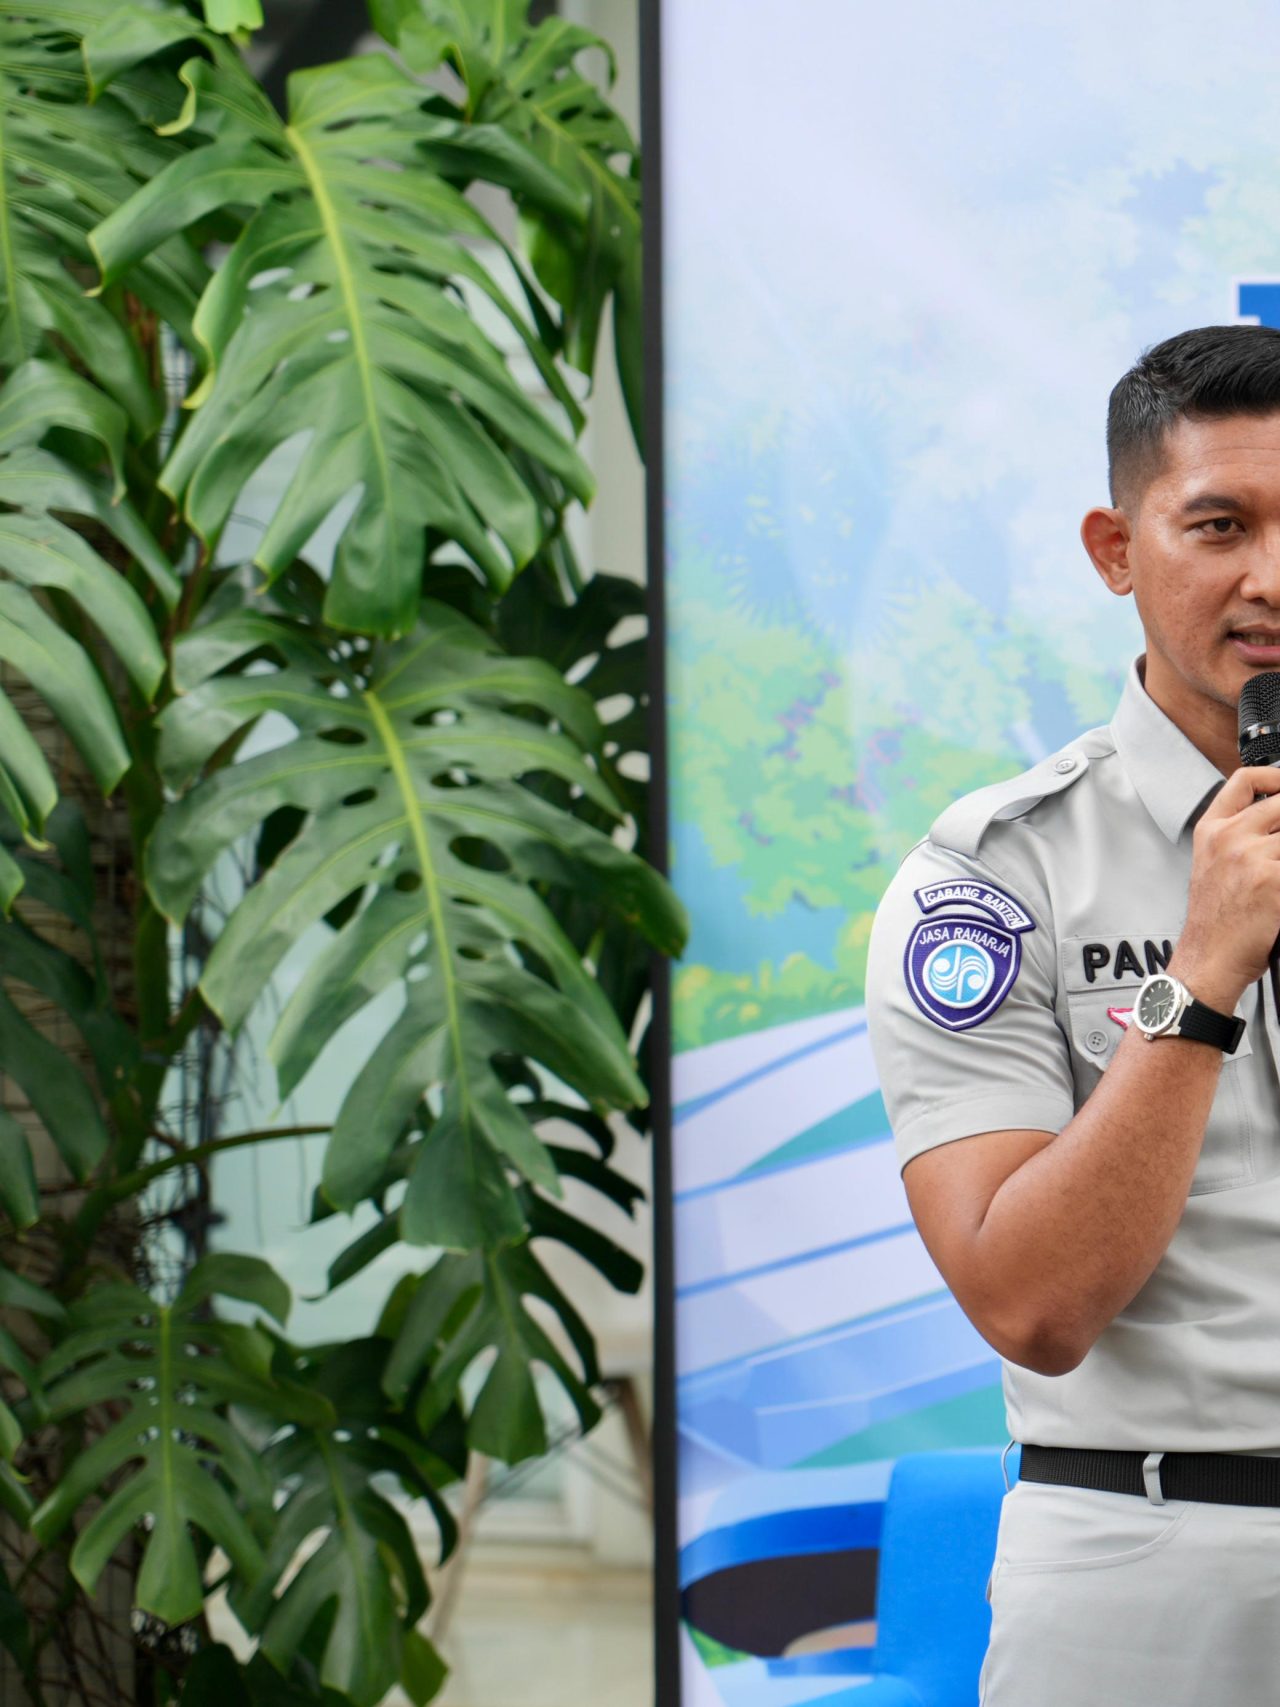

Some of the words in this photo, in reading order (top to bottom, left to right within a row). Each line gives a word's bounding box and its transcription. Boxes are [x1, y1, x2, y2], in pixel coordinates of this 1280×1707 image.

[927, 886, 980, 902] CABANG
[982, 893, 1023, 926] BANTEN
[919, 926, 950, 945] JASA
[953, 927, 1011, 958] RAHARJA
